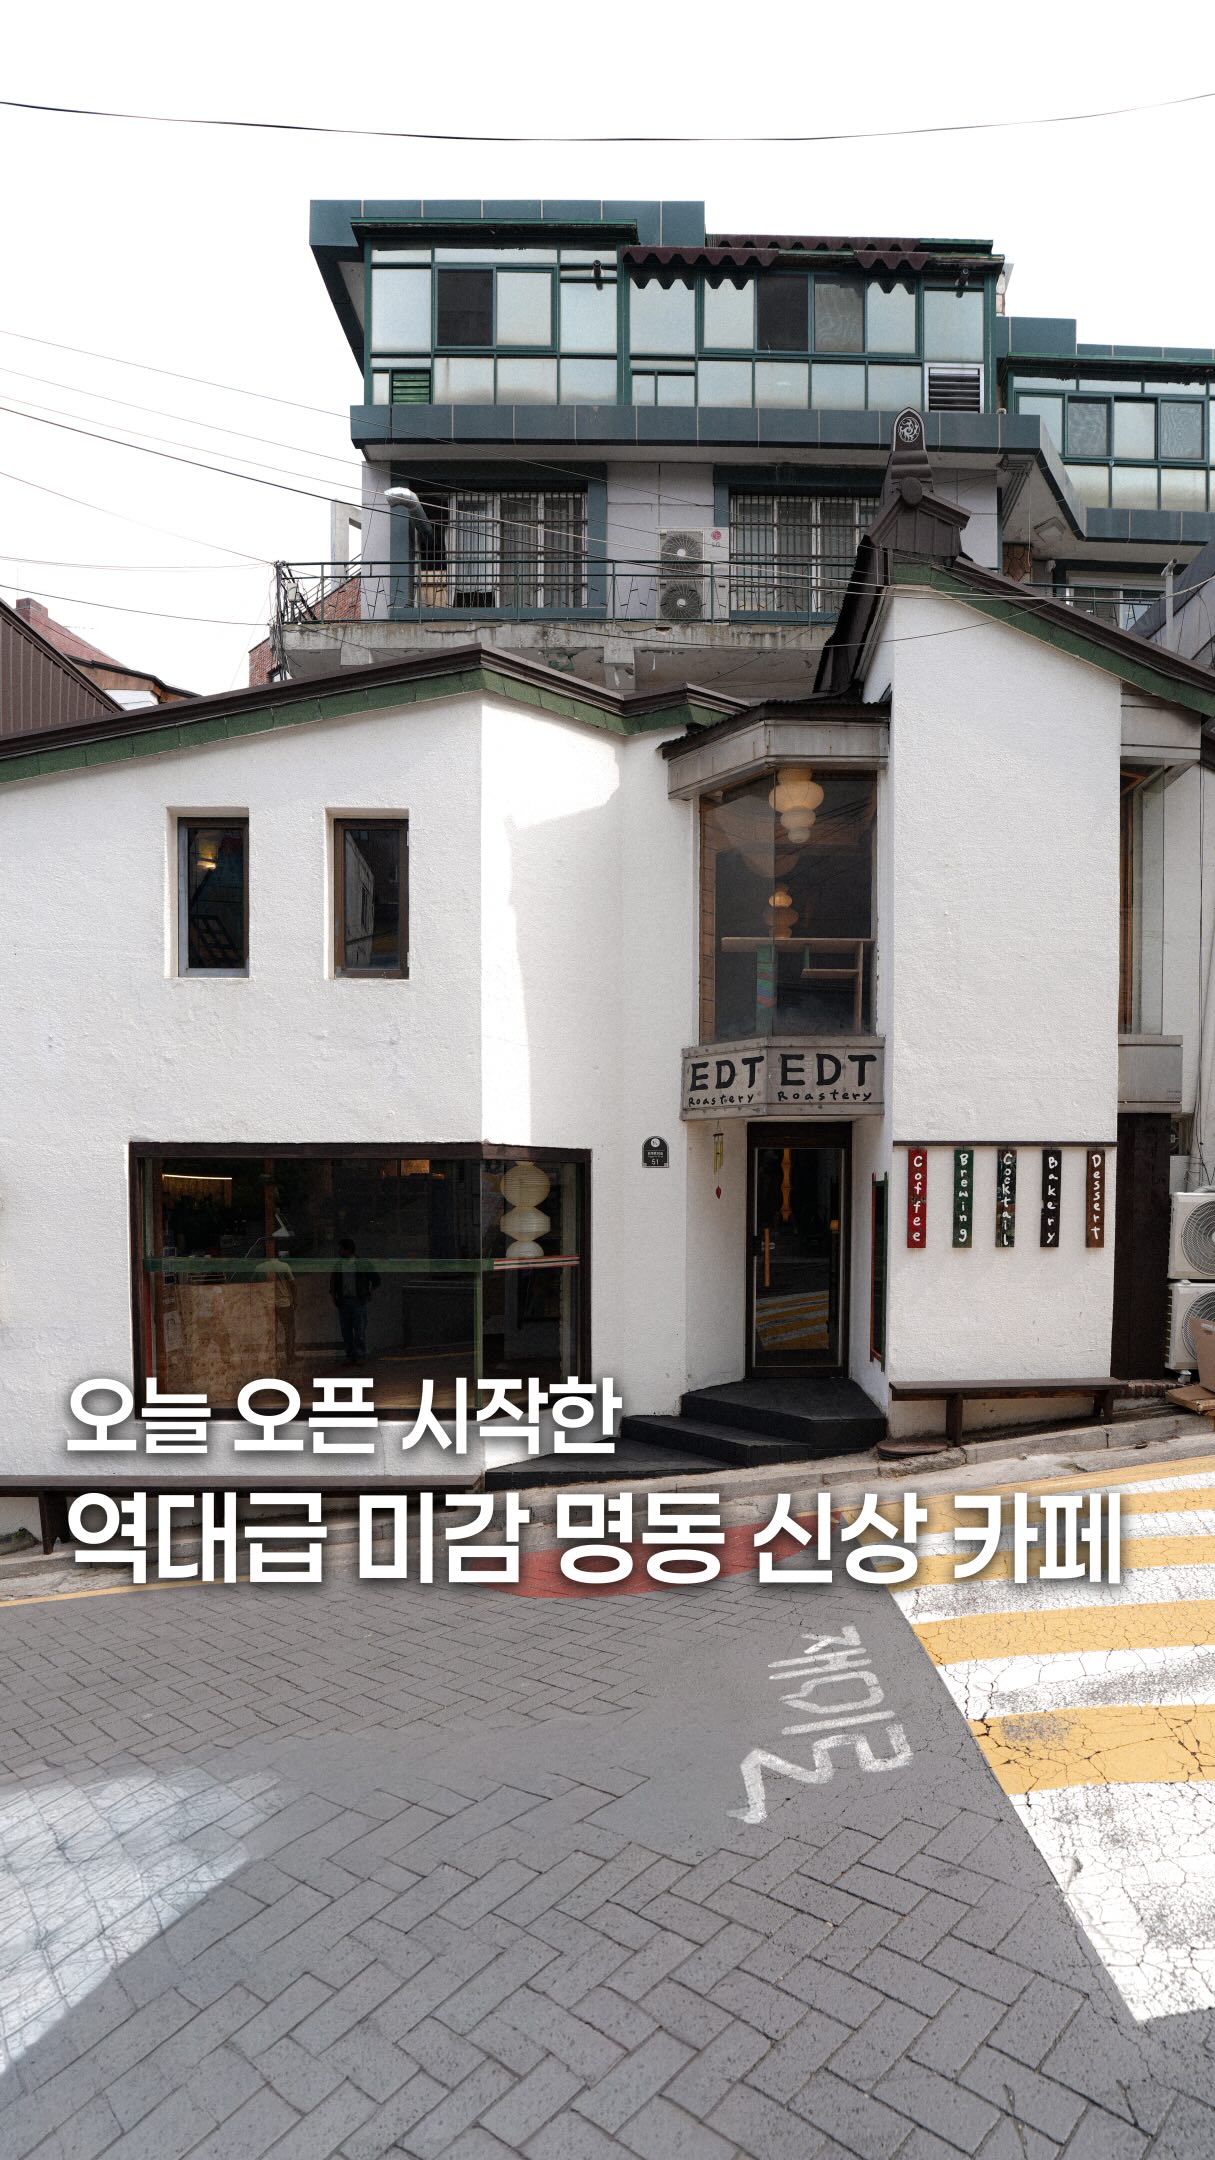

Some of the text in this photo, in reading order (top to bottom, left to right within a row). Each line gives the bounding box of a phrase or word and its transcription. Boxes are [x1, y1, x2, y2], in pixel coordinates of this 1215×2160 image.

[688, 1093, 754, 1107] Roastery
[690, 1056, 765, 1091] EDT
[777, 1089, 872, 1102] Roastery
[779, 1053, 877, 1086] EDT
[651, 1158, 659, 1166] 51
[912, 1155, 923, 1242] Coffee
[958, 1153, 969, 1243] Brewing
[1002, 1153, 1014, 1246] Cocktail
[1046, 1156, 1059, 1244] Bakery
[1090, 1154, 1102, 1241] Dessert
